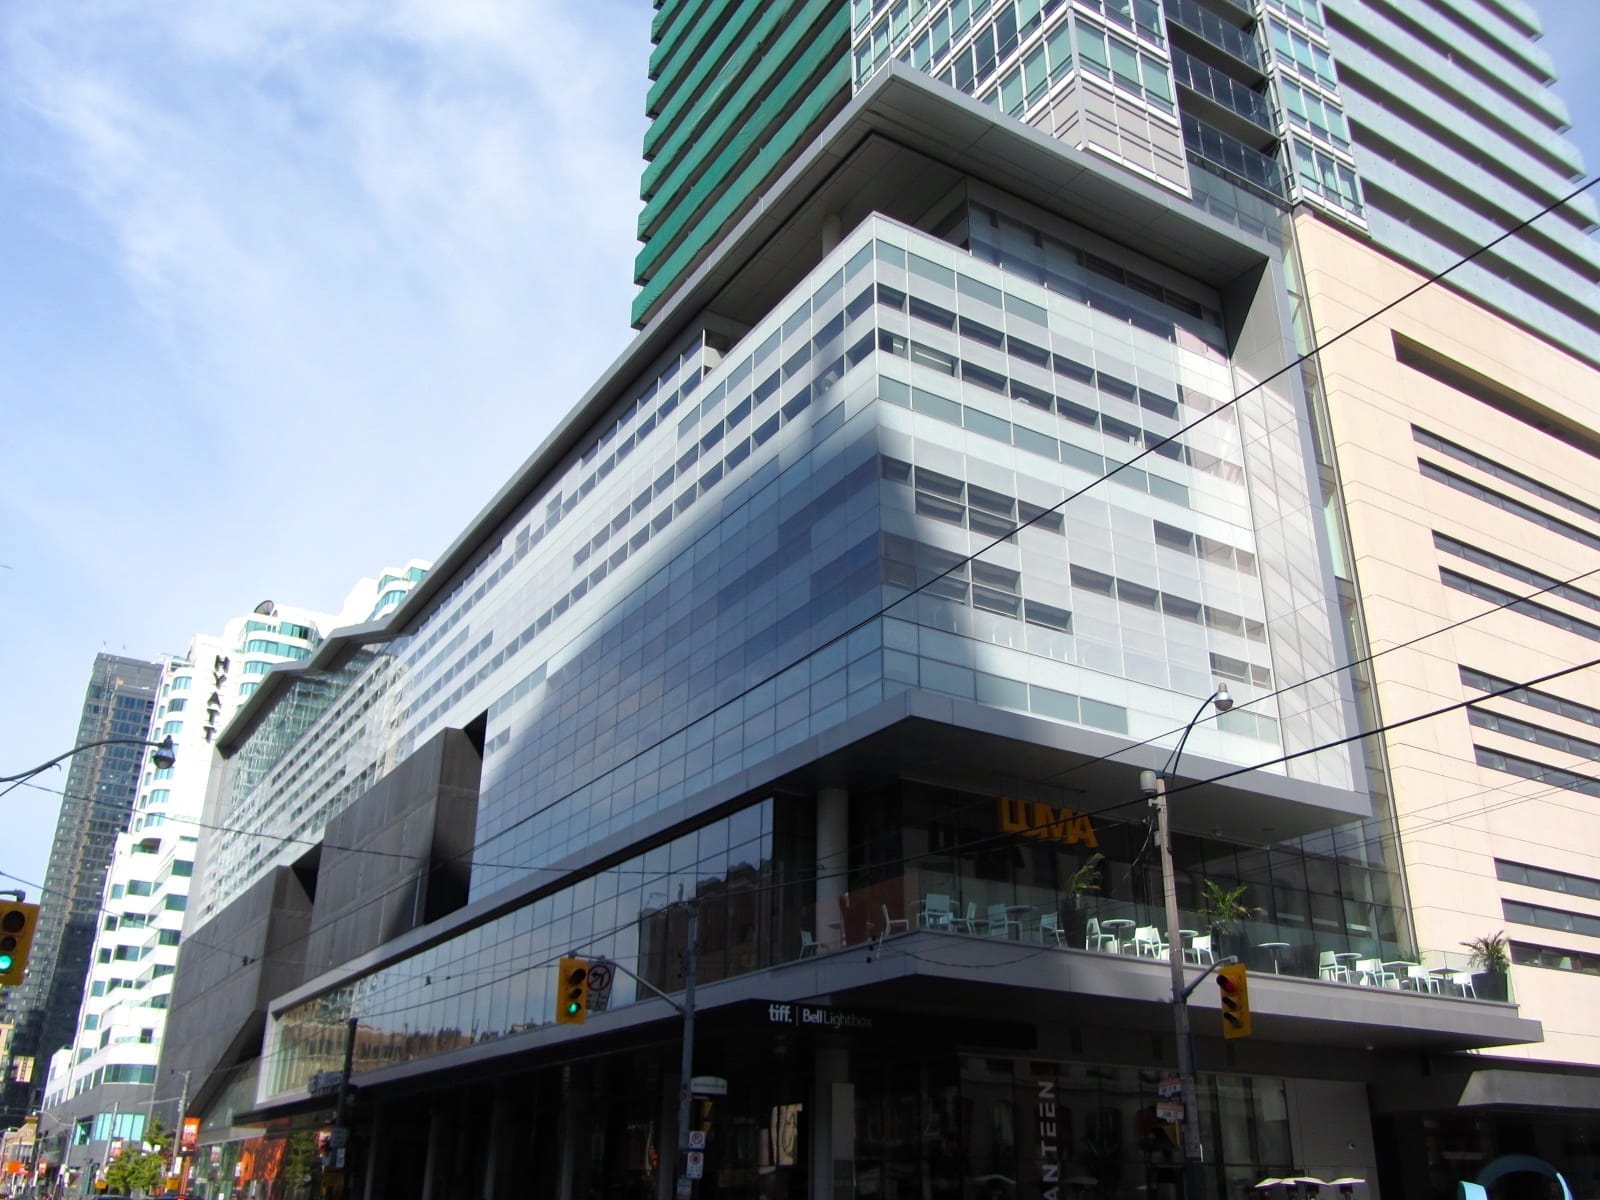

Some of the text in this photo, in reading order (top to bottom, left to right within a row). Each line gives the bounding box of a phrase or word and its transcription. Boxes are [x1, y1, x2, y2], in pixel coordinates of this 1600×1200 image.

[203, 655, 230, 743] HYATT
[1000, 797, 1098, 848] LUMA
[802, 1008, 823, 1024] Bell
